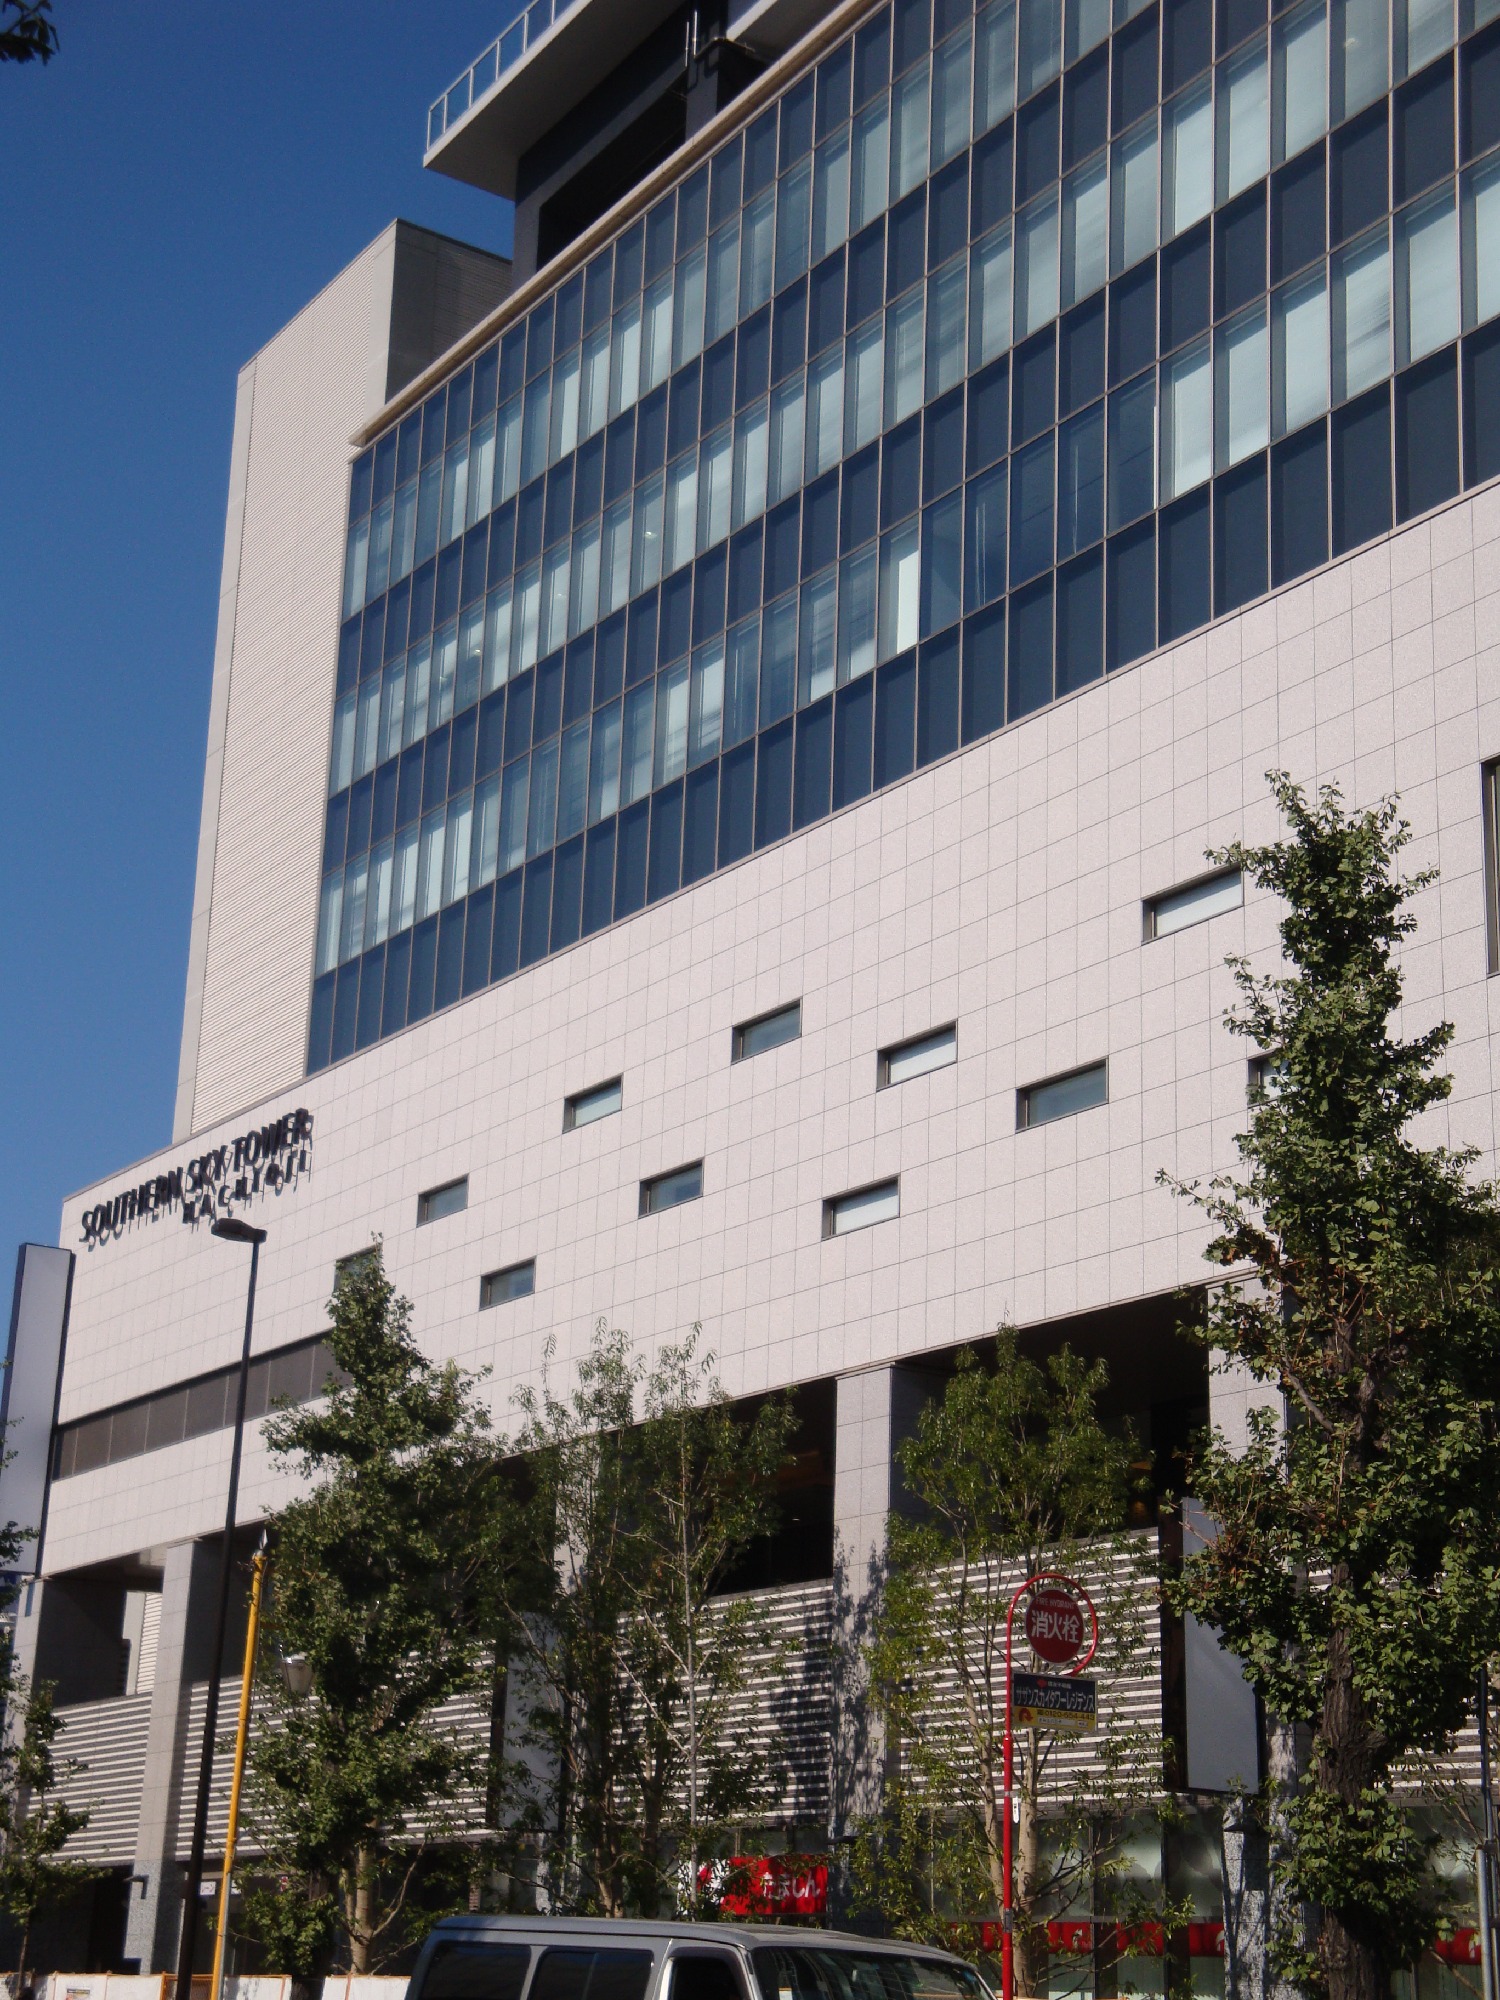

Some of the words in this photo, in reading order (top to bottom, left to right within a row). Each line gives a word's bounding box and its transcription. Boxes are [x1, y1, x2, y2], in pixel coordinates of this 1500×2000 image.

[79, 1166, 184, 1244] SOUTHERN
[187, 1145, 228, 1193] SKY
[231, 1108, 311, 1172] TOWER
[183, 1150, 307, 1224] HACHIOJI
[1035, 1597, 1049, 1606] FIRE
[1031, 1610, 1080, 1643] 消火栓
[1016, 1687, 1095, 1712] サザンスカイタワーレジデンス
